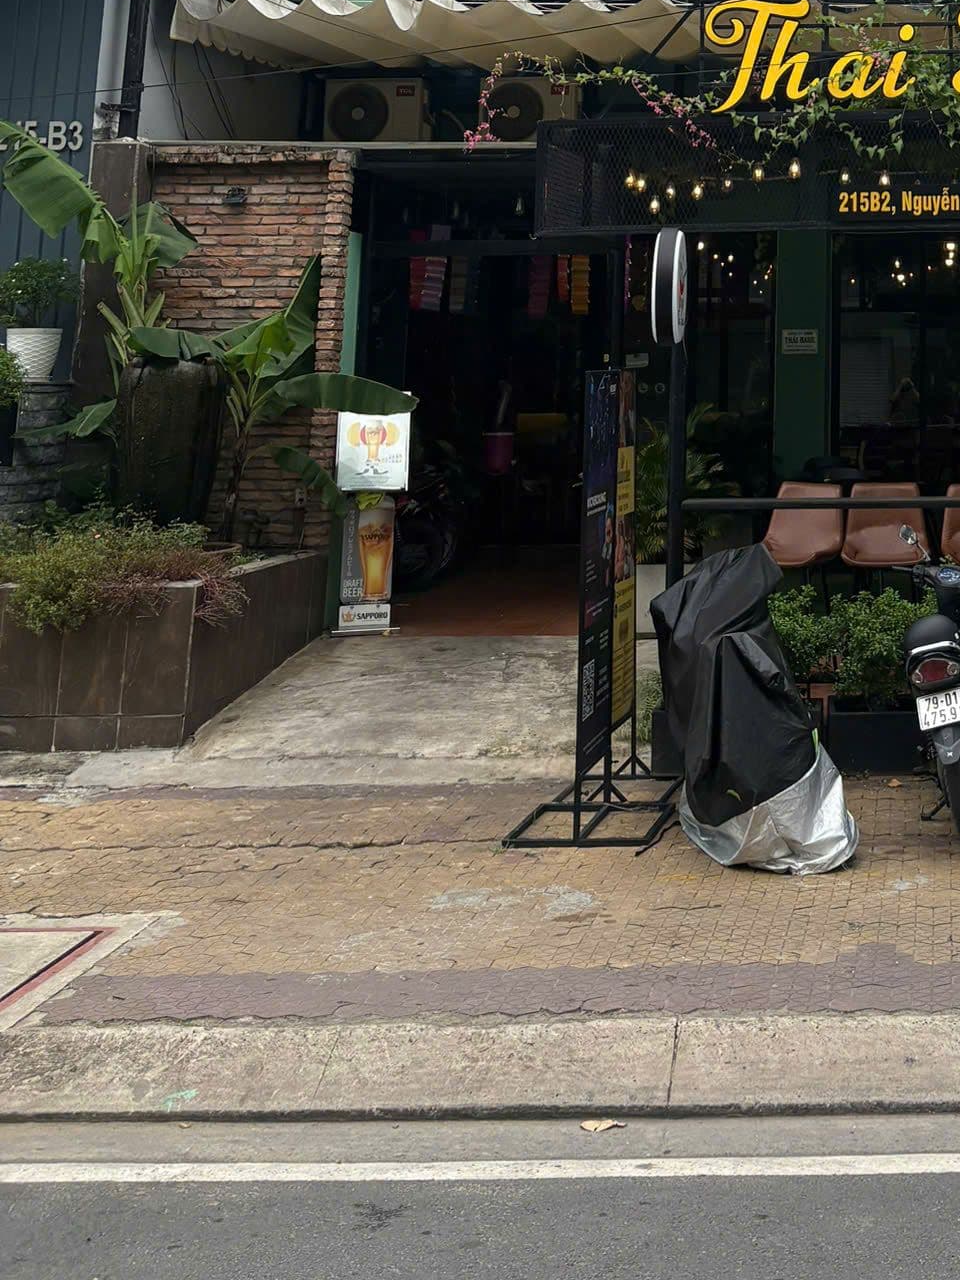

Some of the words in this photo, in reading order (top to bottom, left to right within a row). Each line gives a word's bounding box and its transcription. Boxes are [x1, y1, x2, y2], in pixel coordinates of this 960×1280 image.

[839, 191, 896, 215] 215B2,
[902, 187, 960, 215] Nguyễn
[356, 611, 388, 620] SAPPORO
